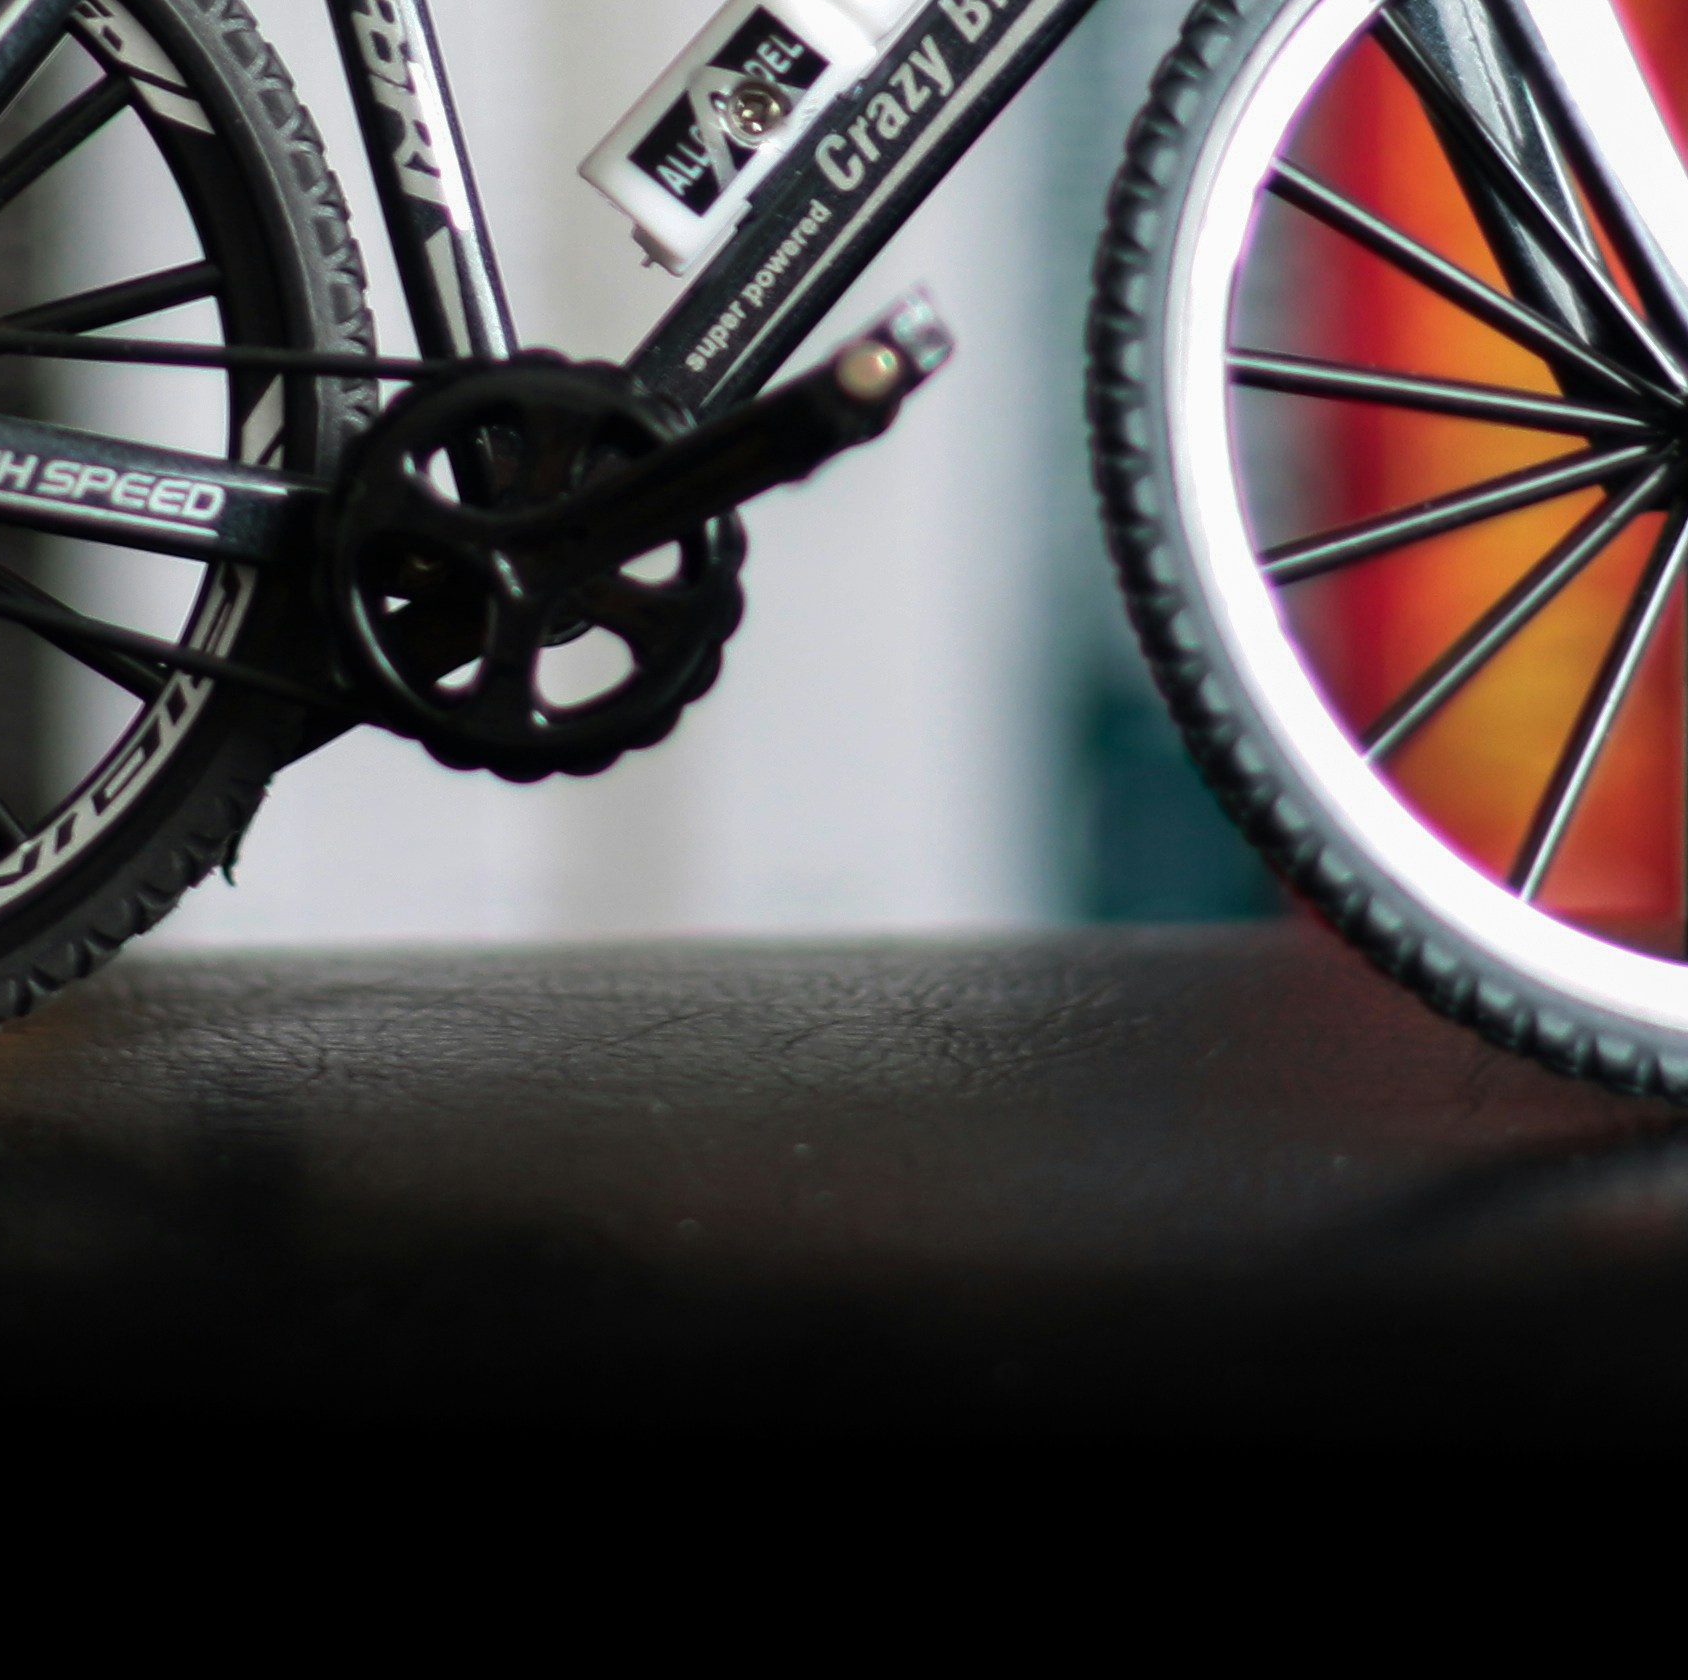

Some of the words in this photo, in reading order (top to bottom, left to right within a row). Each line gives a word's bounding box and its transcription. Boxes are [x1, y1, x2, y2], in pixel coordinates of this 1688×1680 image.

[813, 33, 958, 193] Crazy
[685, 296, 748, 373] super
[741, 197, 833, 310] powered
[37, 459, 226, 522] SPEED
